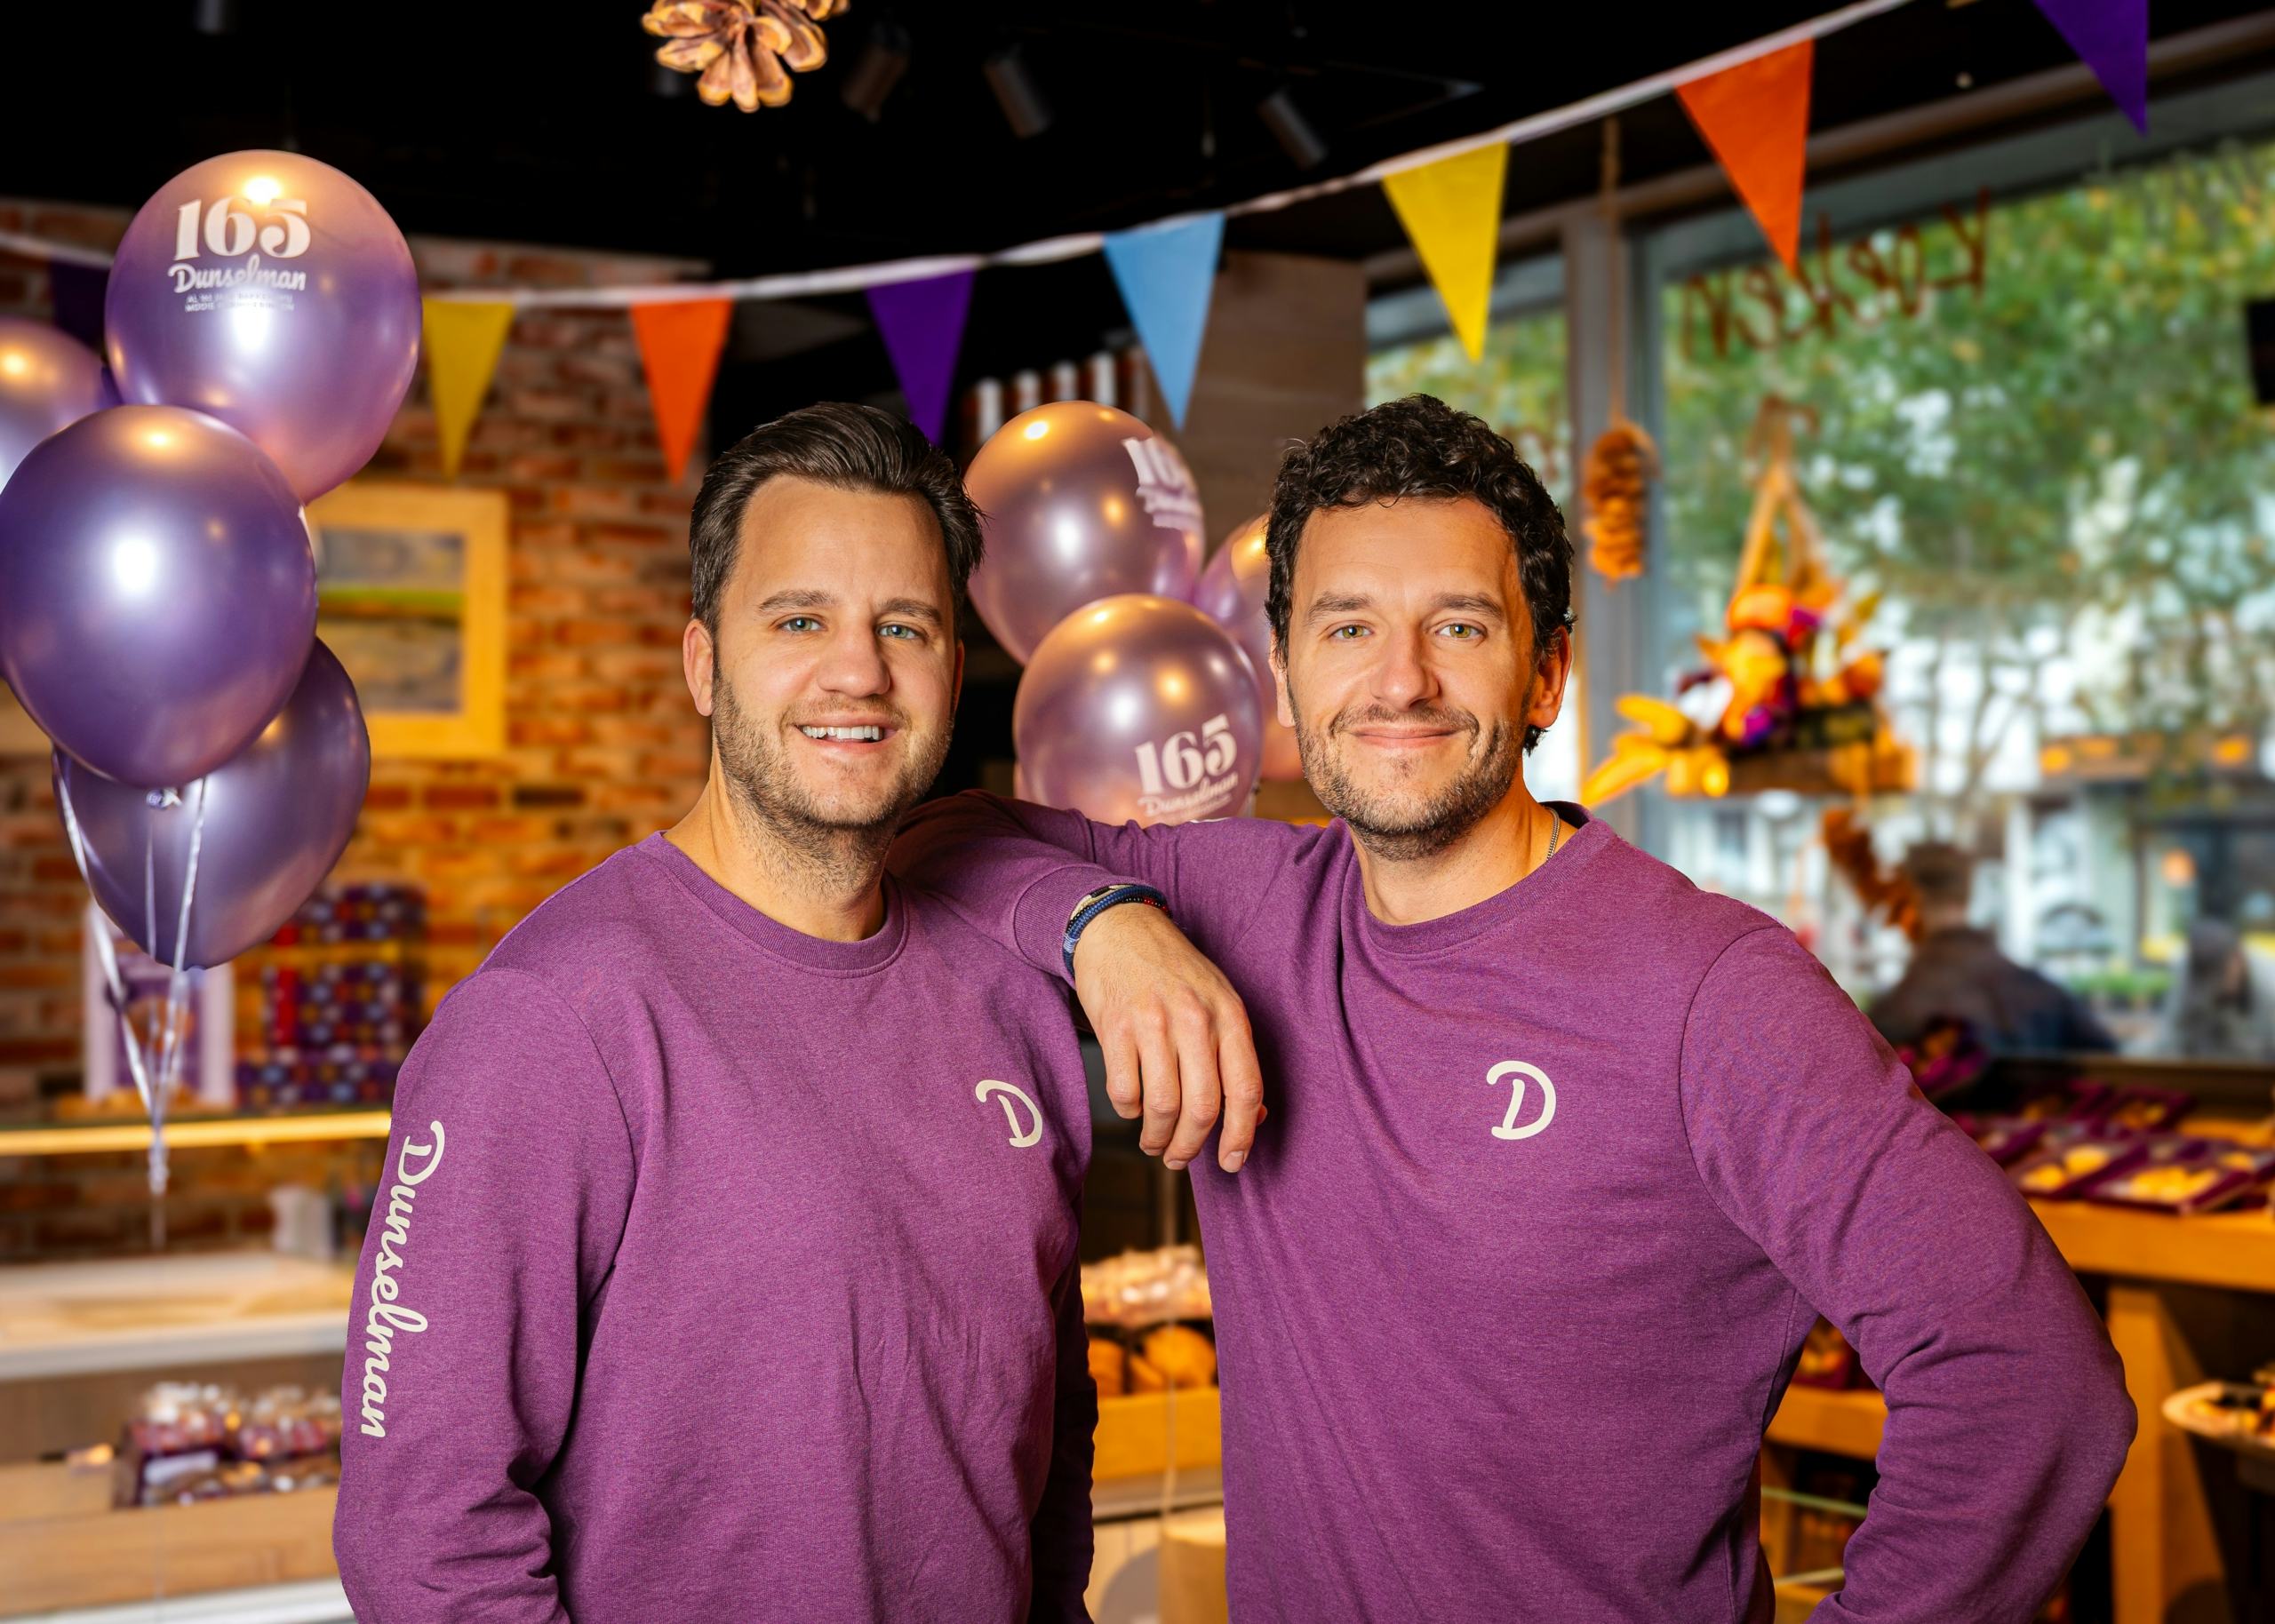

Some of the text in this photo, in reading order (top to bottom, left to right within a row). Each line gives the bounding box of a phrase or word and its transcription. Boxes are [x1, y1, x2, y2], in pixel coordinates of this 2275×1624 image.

[173, 196, 311, 260] 165
[168, 253, 307, 293] Dunselman
[1135, 713, 1238, 795] 165
[975, 1079, 1043, 1148] D
[1485, 1060, 1556, 1141] D
[360, 1120, 446, 1438] Dunselman
